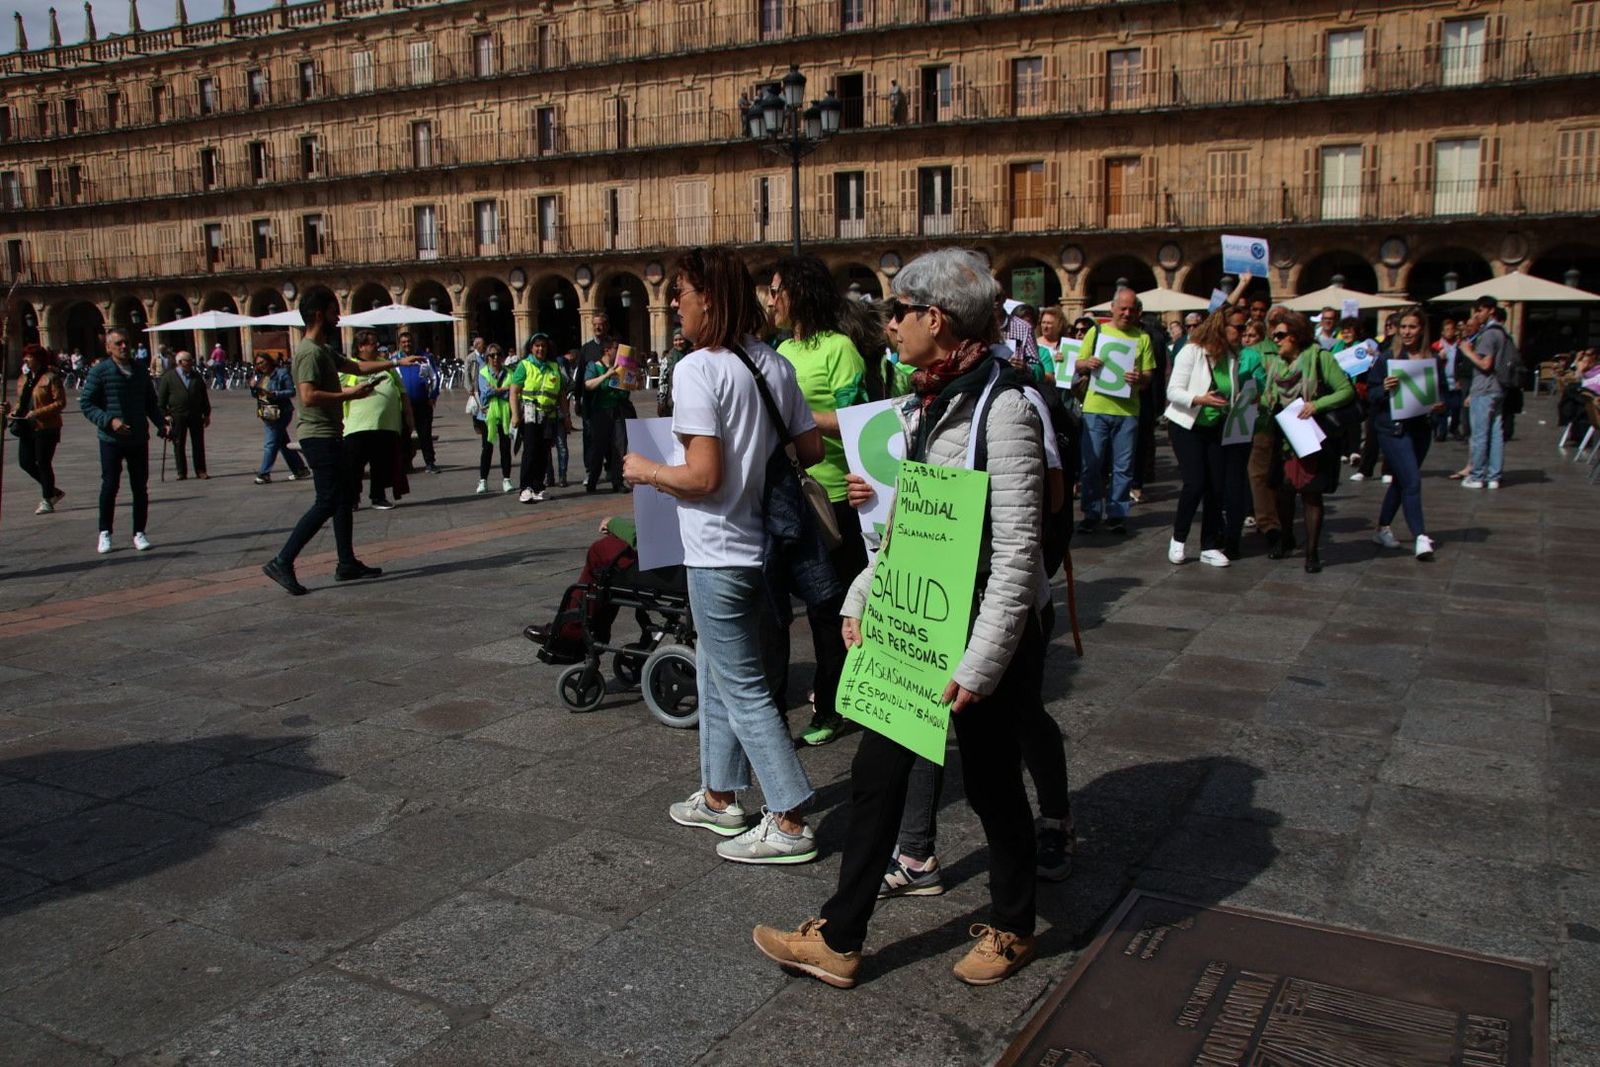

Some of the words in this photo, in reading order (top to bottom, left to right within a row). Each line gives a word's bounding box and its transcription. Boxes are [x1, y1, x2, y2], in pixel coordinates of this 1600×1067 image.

[1095, 341, 1131, 391] S
[1391, 366, 1436, 410] N
[900, 496, 958, 520] MUNDIAL
[872, 561, 949, 621] SALUD
[866, 620, 884, 645] LAS
[887, 631, 949, 671] PERSONAS
[868, 603, 884, 624] PARA
[887, 615, 928, 643] TODAS
